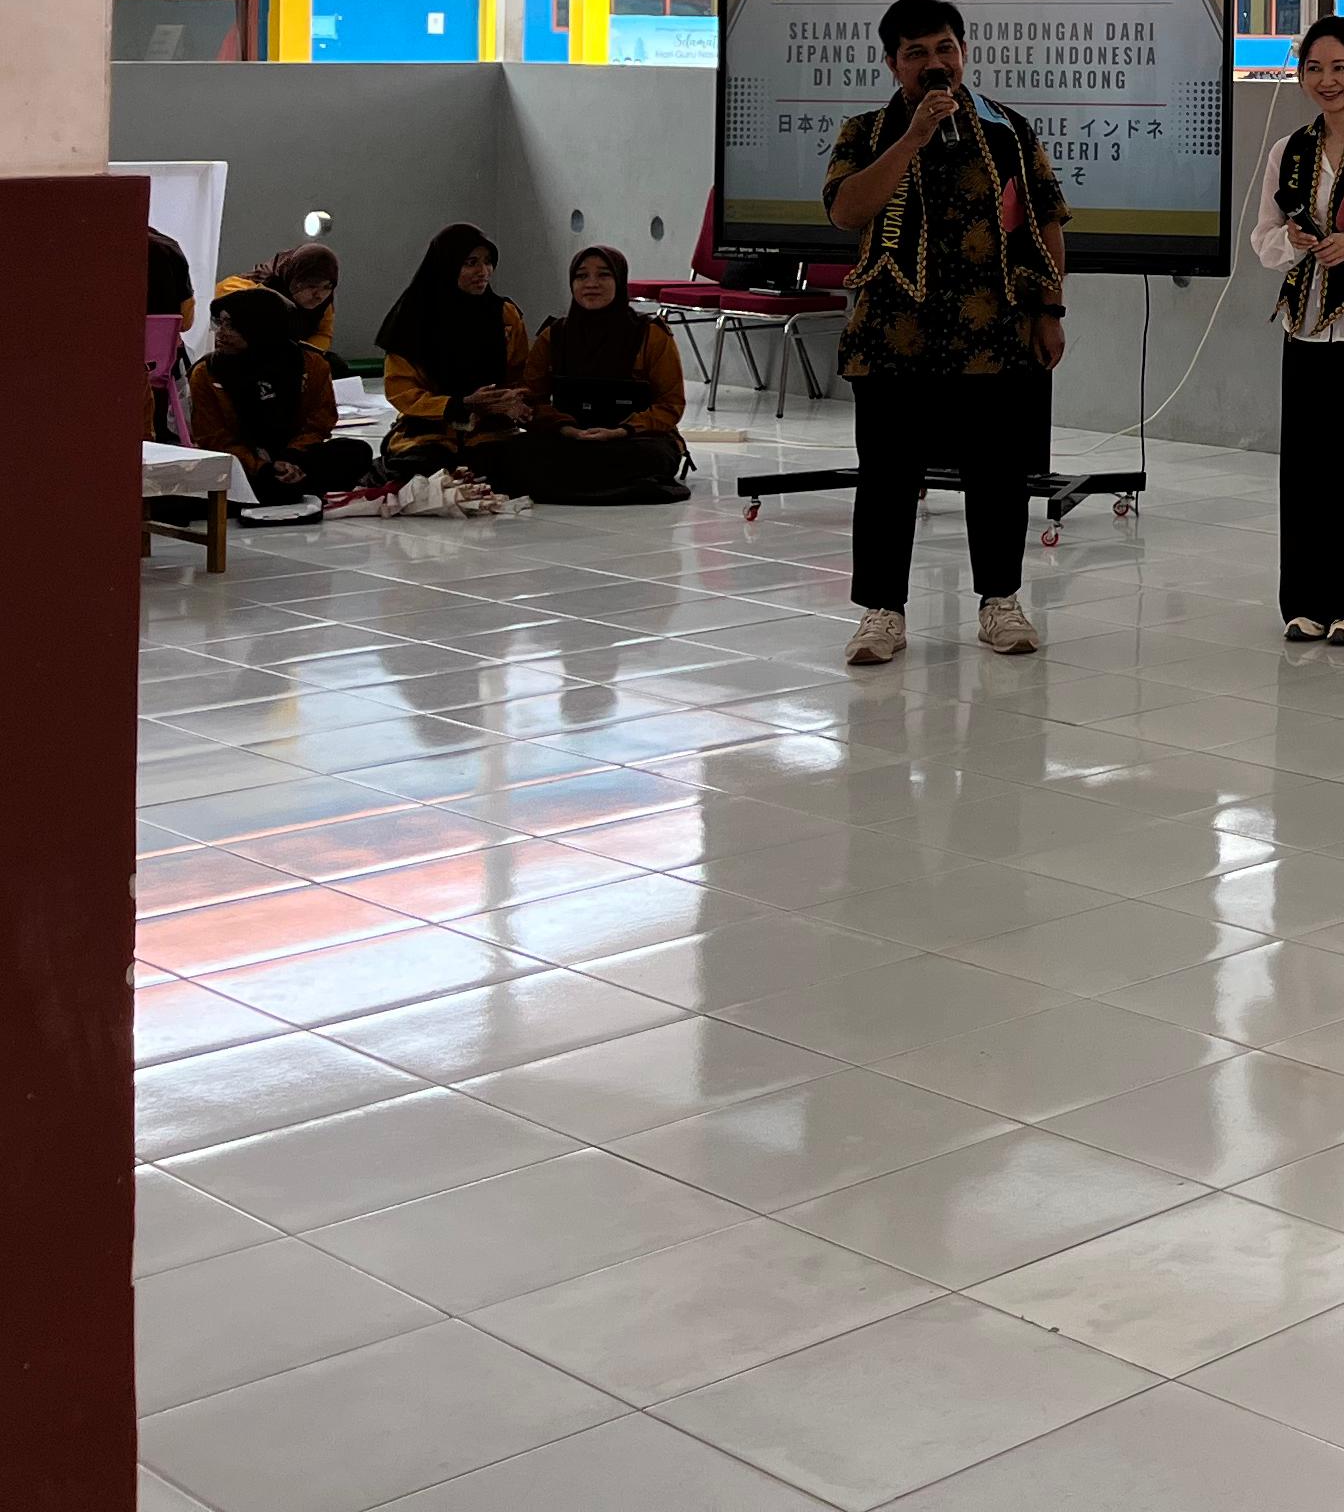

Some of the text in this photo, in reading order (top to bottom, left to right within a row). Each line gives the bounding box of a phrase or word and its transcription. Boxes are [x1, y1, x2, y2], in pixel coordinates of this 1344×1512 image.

[789, 22, 1154, 42] SELAMAT ROMBONGAN DARI
[786, 45, 855, 64] JEPANG
[965, 46, 1034, 65] OOGLE
[1046, 46, 1156, 65] INDONESIA
[813, 68, 832, 86] DI
[843, 68, 881, 86] SMP
[972, 69, 982, 88] 3
[993, 69, 1127, 89] TENGGARONG
[1033, 117, 1068, 136] GLE
[1080, 118, 1163, 139] インドネ
[1111, 142, 1121, 161] 3
